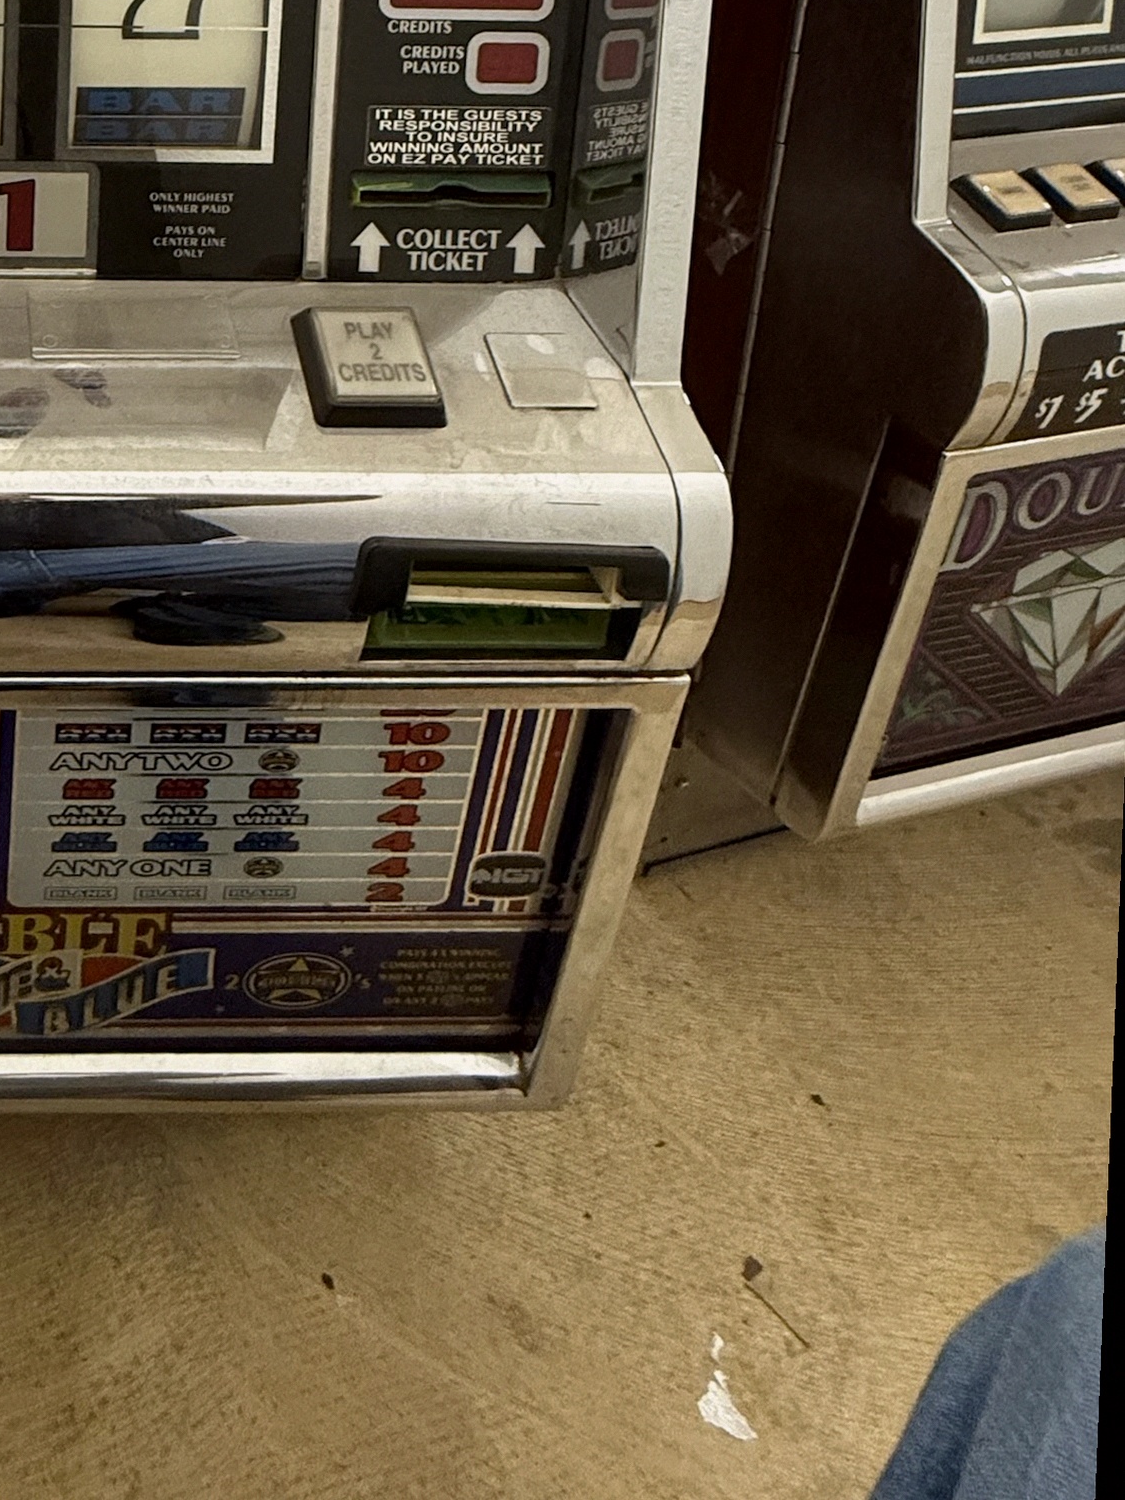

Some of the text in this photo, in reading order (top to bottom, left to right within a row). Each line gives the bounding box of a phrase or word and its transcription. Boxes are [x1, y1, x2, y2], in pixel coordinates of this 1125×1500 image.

[387, 19, 452, 34] CREDITS
[400, 45, 465, 59] CREDITS
[402, 61, 460, 75] PLAYED
[86, 88, 231, 115] BAR
[375, 108, 543, 122] IT IS THE GUESTS
[82, 118, 229, 142] BAR
[378, 119, 539, 133] RESPONSIBILITY
[405, 131, 509, 143] TO INSURE
[369, 142, 543, 154] WINNING AMOUNT
[367, 153, 544, 166] ON EZ PAY TICKET
[149, 191, 234, 203] ONLY HIGHEST
[153, 203, 231, 214] WINNER PAID
[164, 225, 215, 235] PAYS ON
[153, 237, 227, 247] CENTER LINE
[396, 228, 502, 250] COLLECT
[173, 248, 205, 258] ONLY
[407, 251, 488, 272] TICKET
[343, 321, 394, 341] PLAY
[370, 343, 384, 360] 2
[338, 362, 428, 383] CREDITS
[939, 465, 1125, 574] DOU
[383, 721, 451, 745] 10
[377, 749, 446, 774] 10
[43, 963, 180, 1036] BLUE
